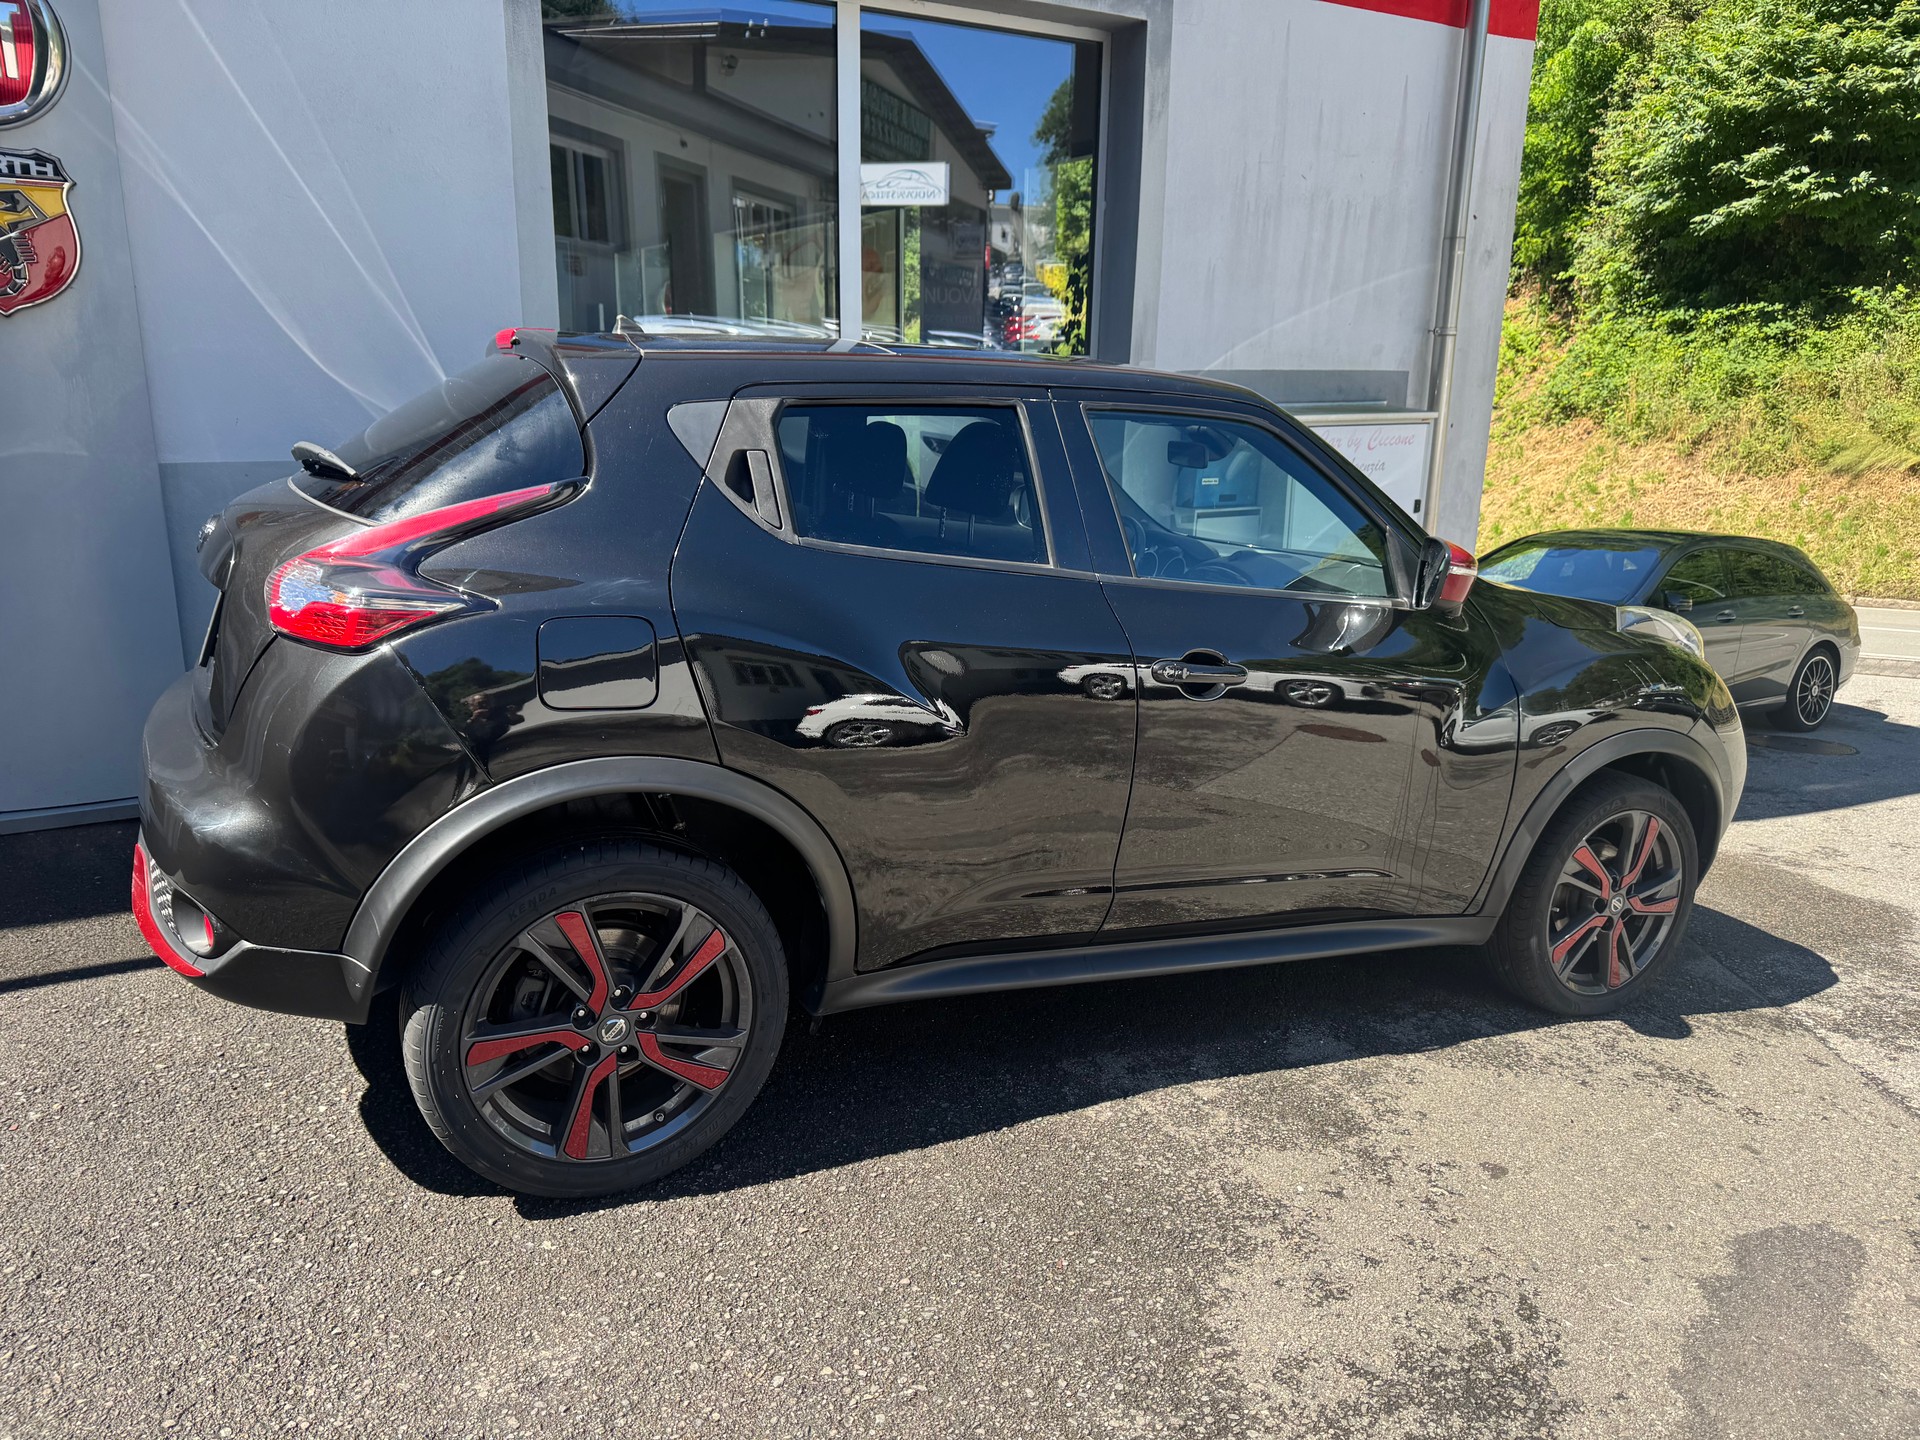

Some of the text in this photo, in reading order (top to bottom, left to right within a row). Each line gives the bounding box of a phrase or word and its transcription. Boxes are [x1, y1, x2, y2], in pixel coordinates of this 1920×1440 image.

[1346, 430, 1361, 454] by
[1367, 428, 1415, 451] Ciccone
[507, 886, 558, 922] KENDA
